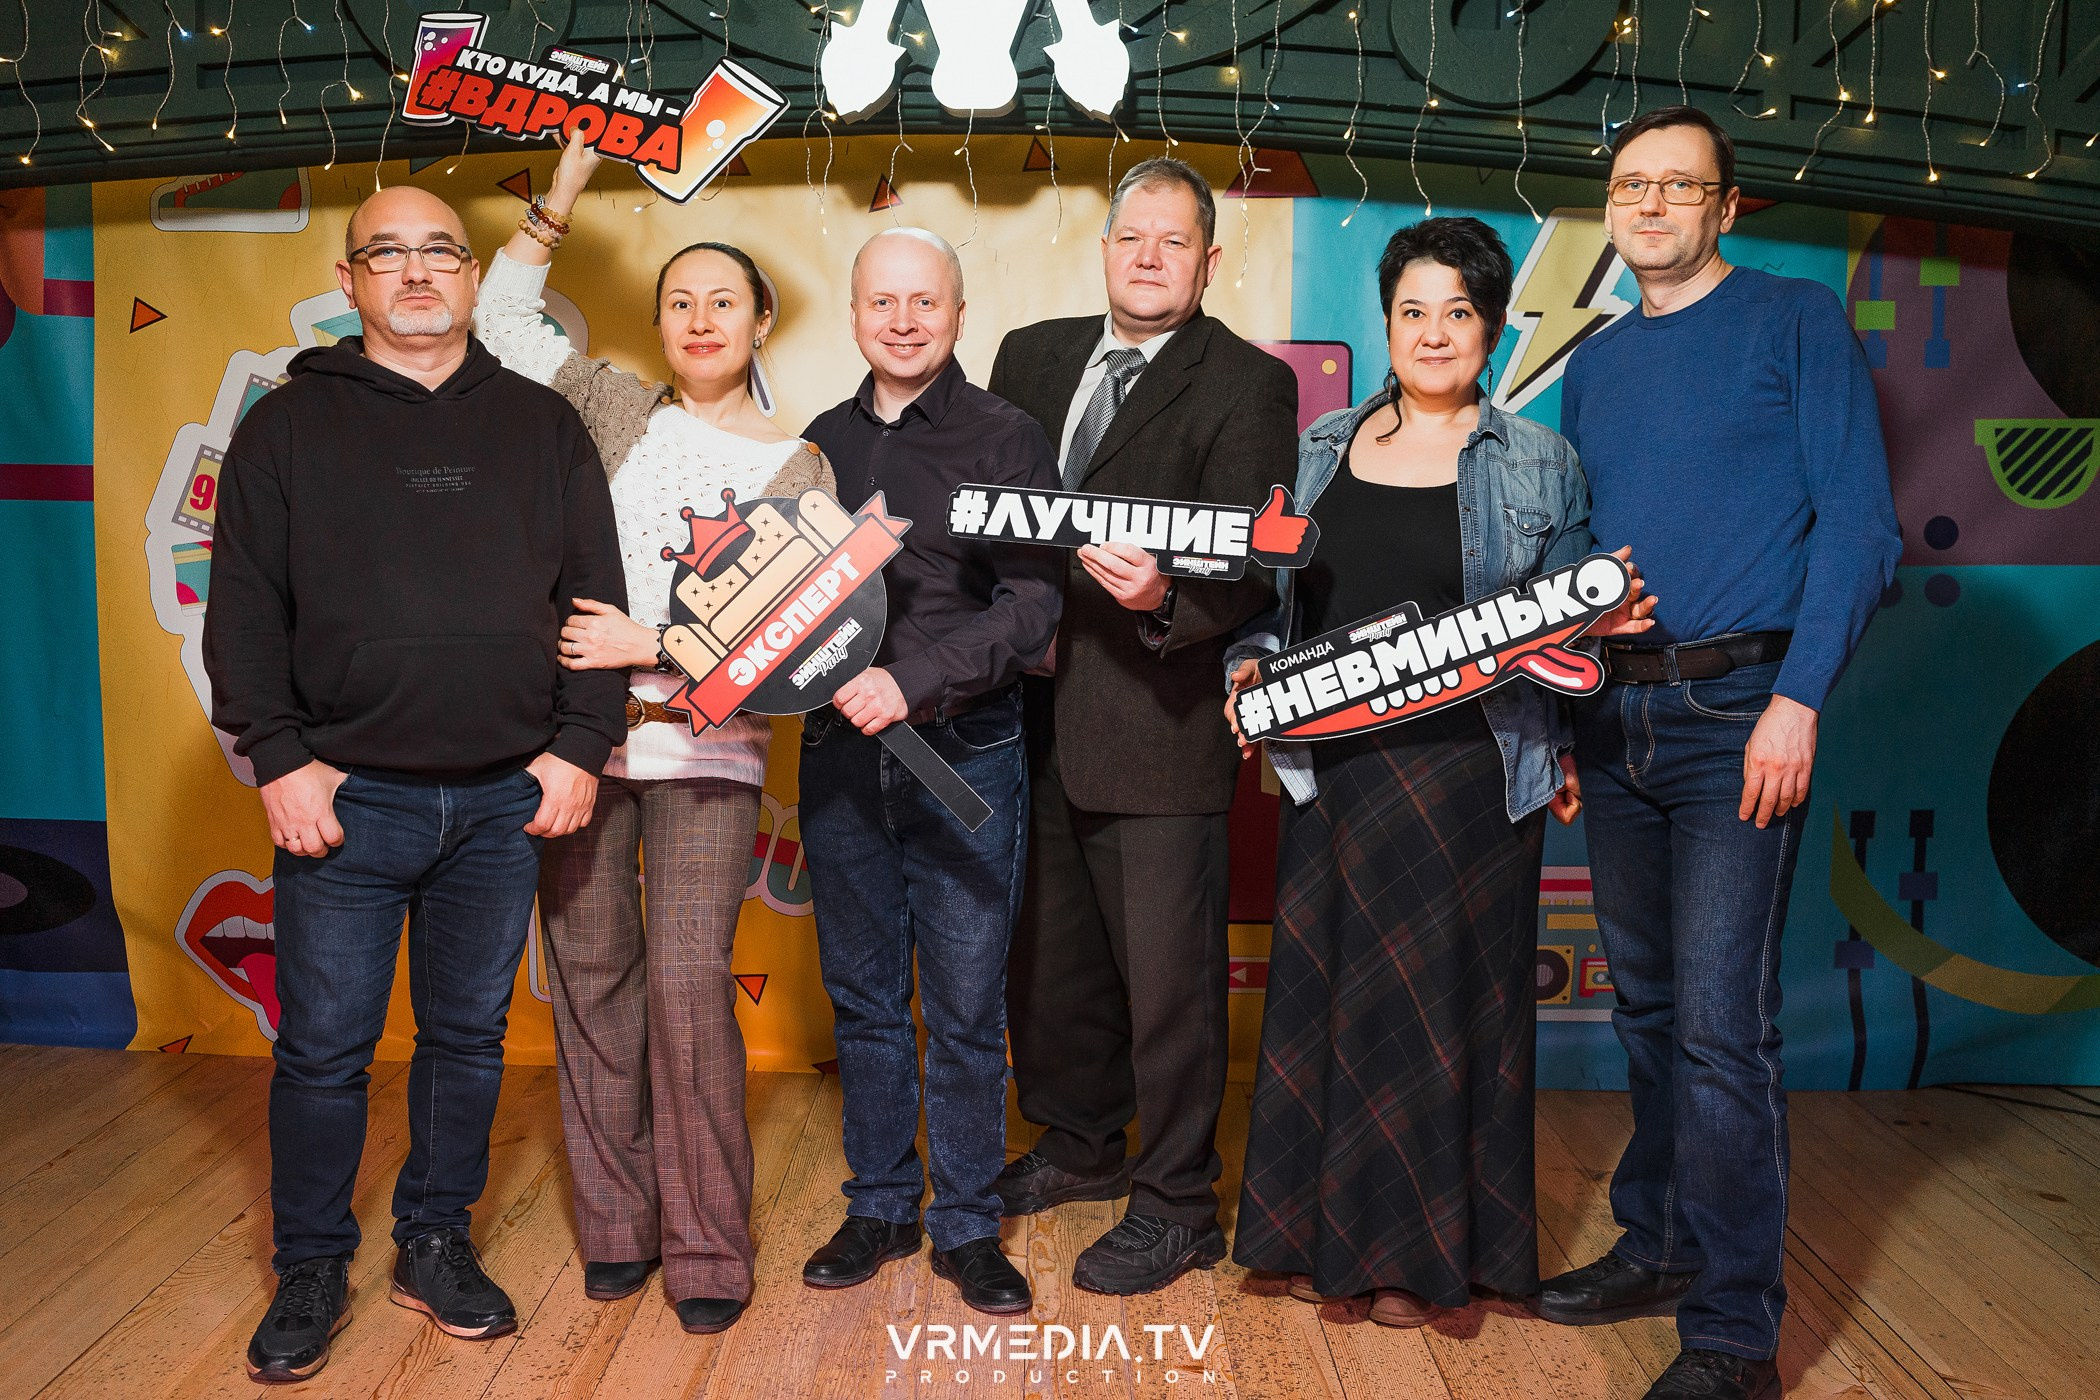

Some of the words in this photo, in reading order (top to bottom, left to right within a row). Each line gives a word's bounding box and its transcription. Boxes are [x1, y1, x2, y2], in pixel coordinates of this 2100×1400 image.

[455, 48, 512, 75] КТО
[506, 61, 584, 99] КУДА,
[587, 82, 613, 102] А
[617, 89, 664, 116] МЫ
[418, 67, 684, 172] #ВДРОВА
[189, 473, 218, 512] 9
[432, 466, 442, 475] de
[443, 465, 476, 475] Peinture
[950, 489, 1251, 558] #ЛУЧШИЕ
[727, 551, 861, 687] ЭКСПЕРТ
[1237, 558, 1626, 738] #НЕВМИНЬКО
[818, 645, 849, 677] Party
[1269, 641, 1335, 674] КОМАНДА
